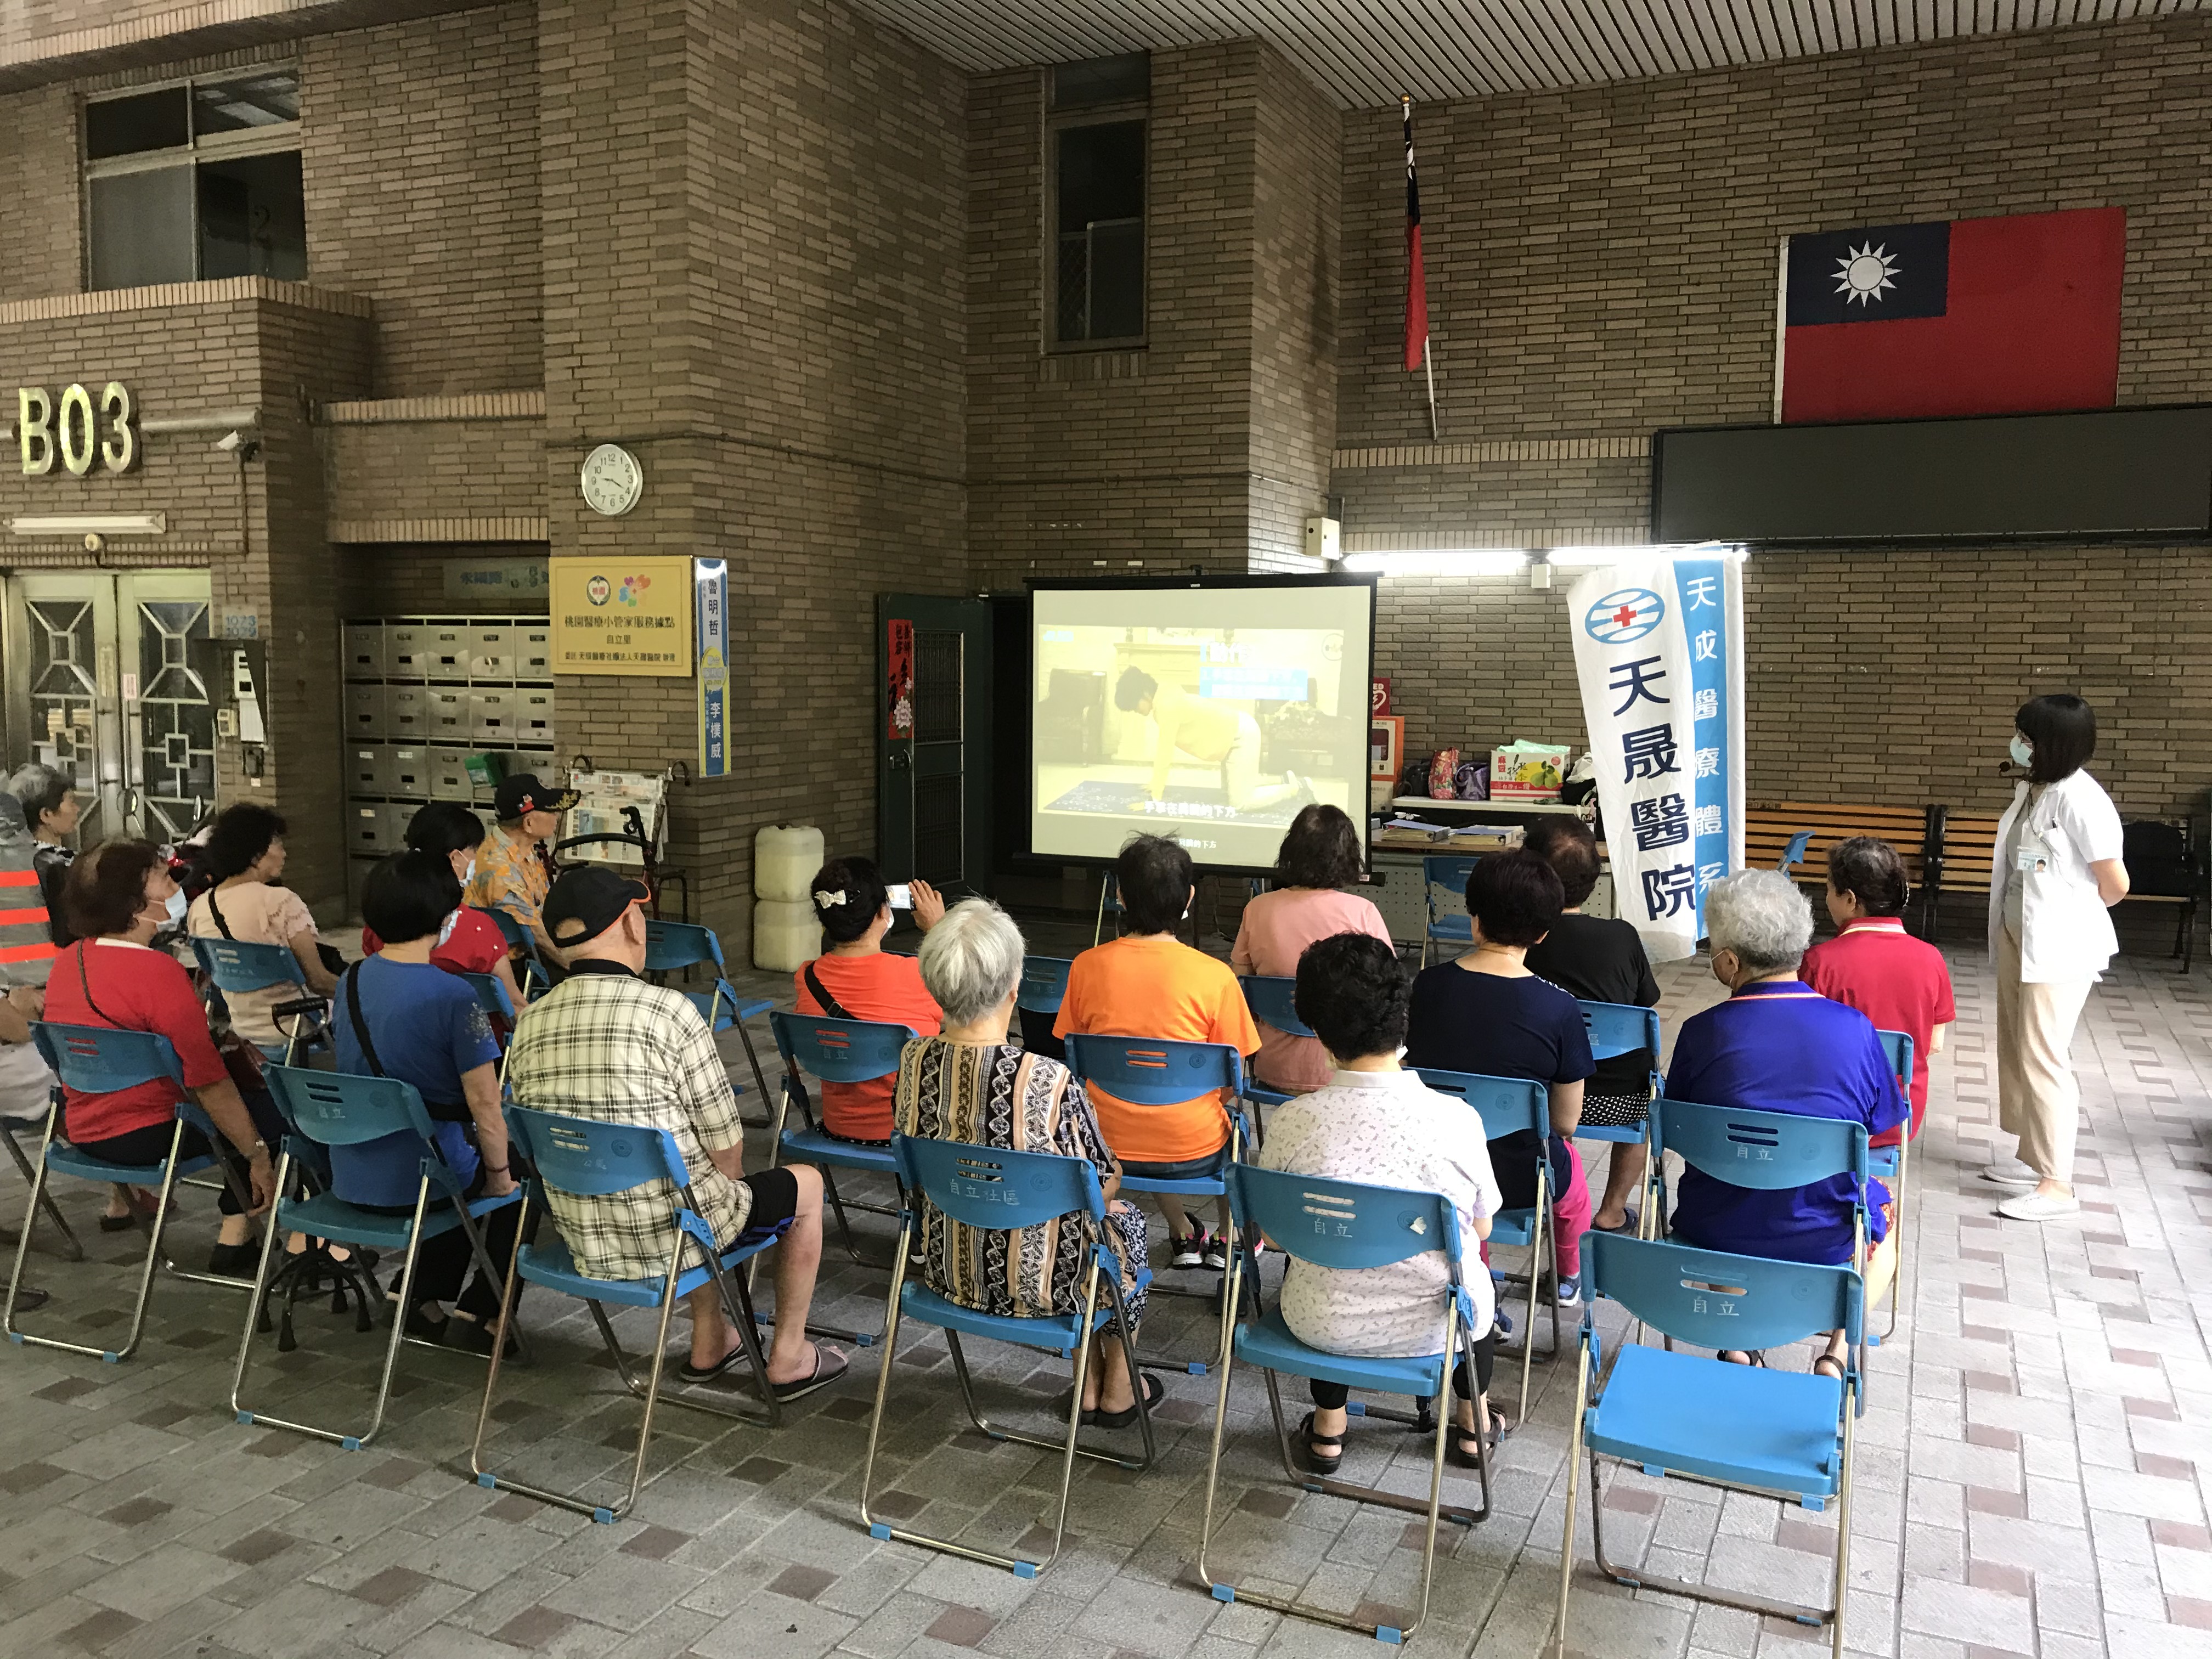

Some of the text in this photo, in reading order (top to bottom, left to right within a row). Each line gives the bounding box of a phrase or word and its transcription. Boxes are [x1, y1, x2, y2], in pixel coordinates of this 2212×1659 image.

[601, 457, 607, 465] 11
[608, 453, 616, 462] 12
[594, 465, 601, 474] 10
[625, 464, 630, 472] 2
[591, 476, 596, 486] 9
[628, 475, 633, 484] 3
[595, 488, 600, 496] 8
[601, 495, 606, 504] 7
[610, 498, 616, 507] 6
[619, 494, 624, 503] 5
[606, 634, 631, 644] 自立里
[1686, 576, 1725, 894] 天成醫療體系
[1609, 655, 1696, 921] 天晟醫院
[823, 1046, 848, 1060] 自立
[1737, 1144, 1773, 1160] 自立
[1314, 1218, 1353, 1238] 自立
[1694, 1296, 1739, 1316] 自立
